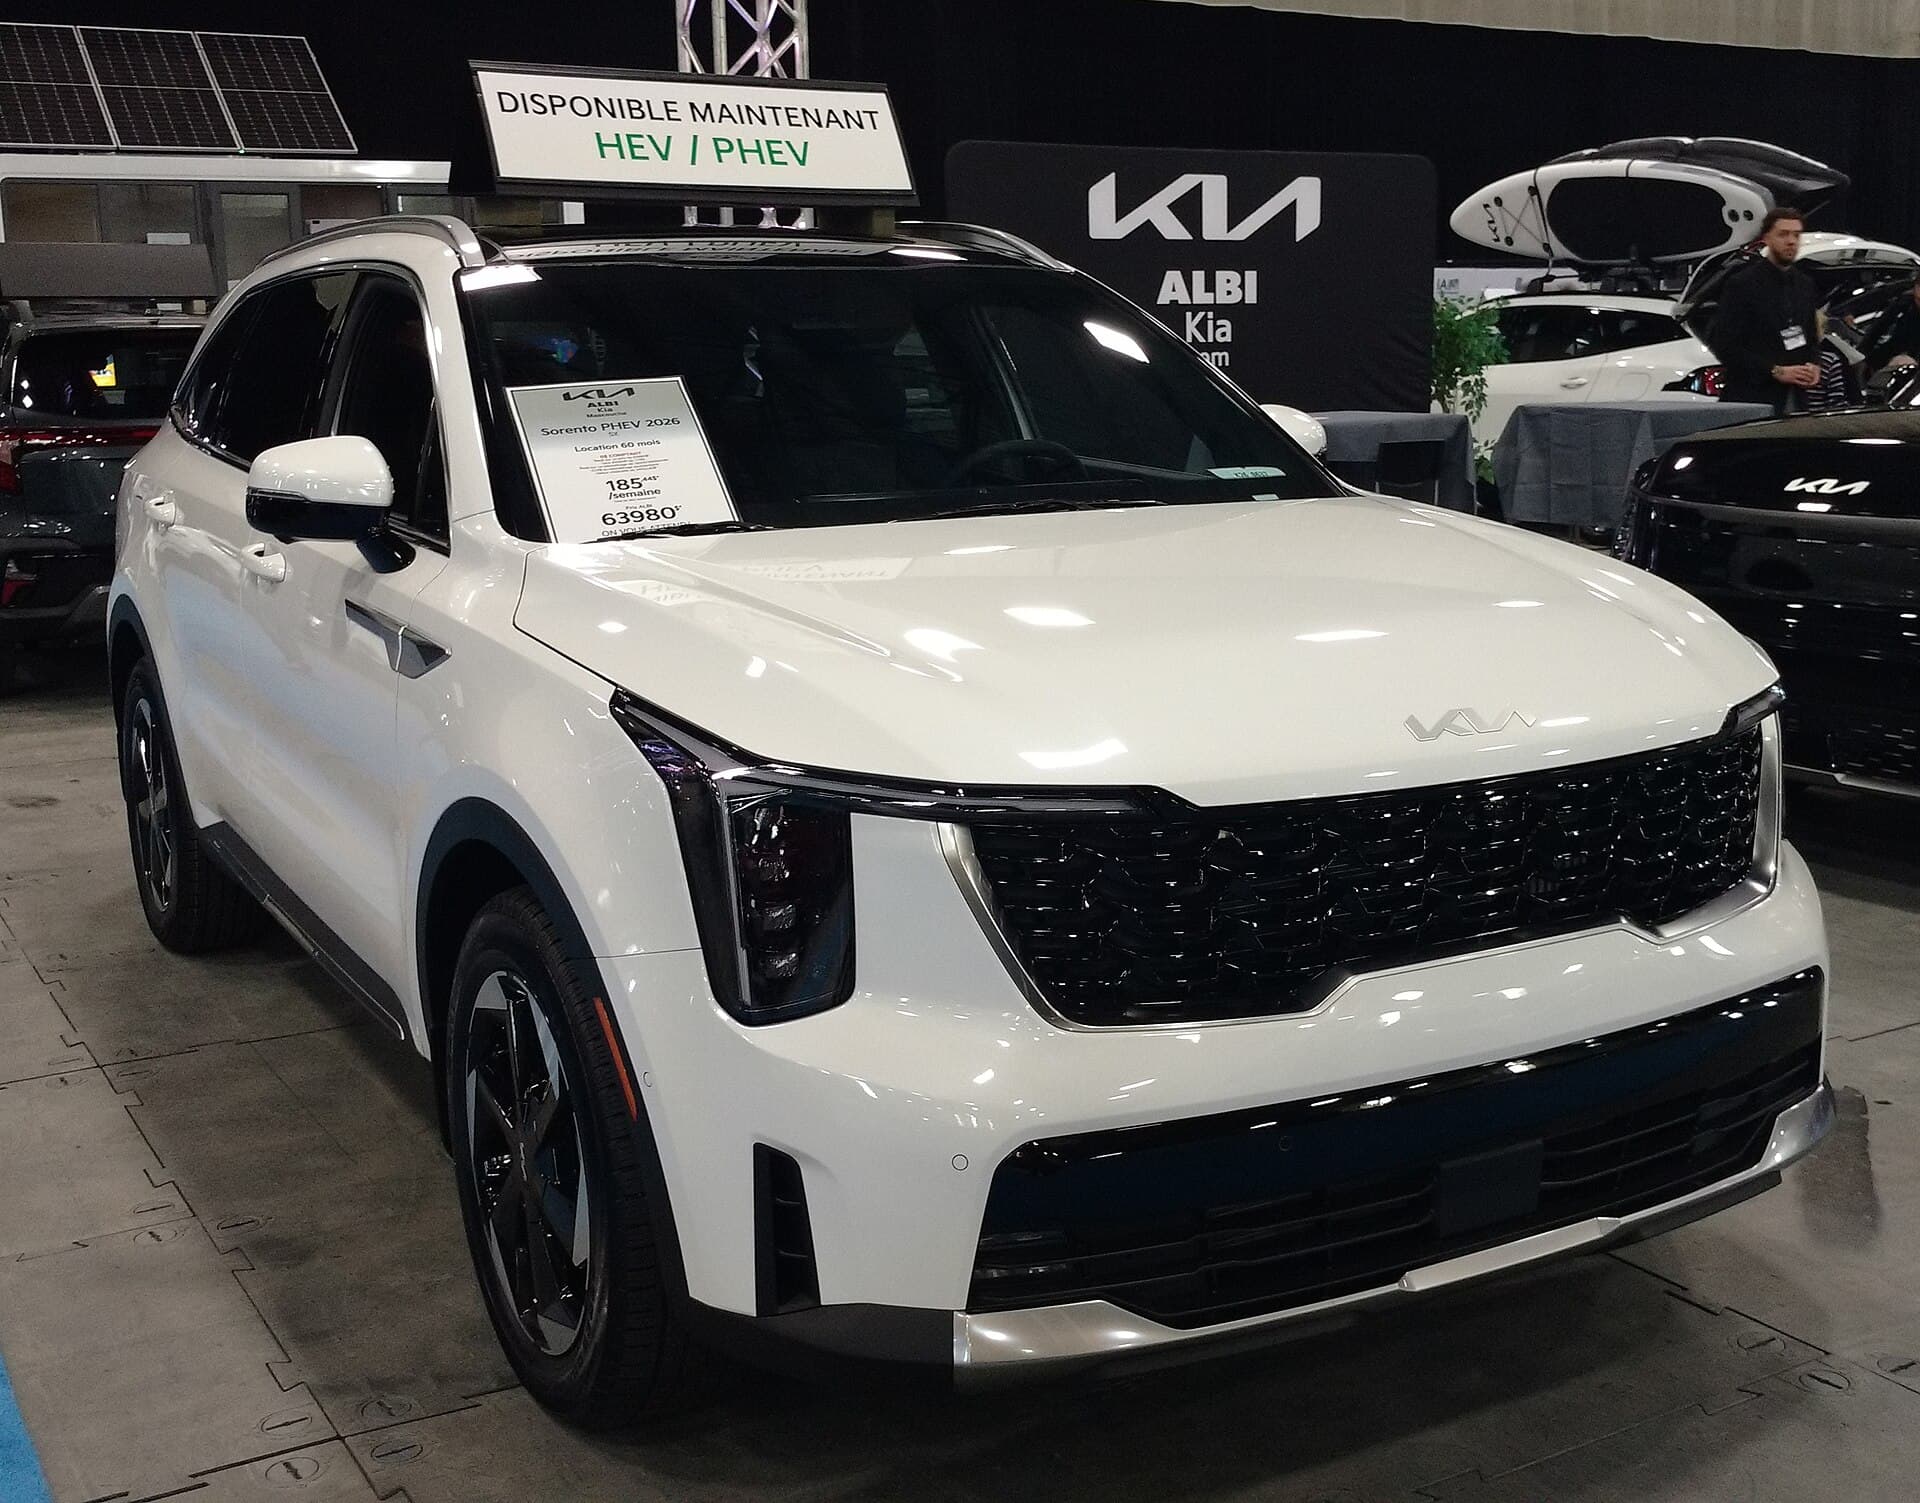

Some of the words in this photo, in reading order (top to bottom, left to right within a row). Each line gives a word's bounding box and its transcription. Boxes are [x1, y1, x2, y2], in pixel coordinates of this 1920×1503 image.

[496, 90, 682, 122] DISPONIBLE
[689, 101, 879, 131] MAINTENANT
[595, 131, 673, 162] HEV
[689, 134, 699, 166] /
[711, 136, 810, 167] PHEV
[1088, 171, 1322, 243] KIA
[1156, 270, 1258, 305] ALBI
[1185, 311, 1232, 343] Kia
[562, 387, 635, 401] KIA
[587, 400, 619, 408] ALBI
[541, 425, 597, 436] Sorento
[601, 419, 641, 432] PHEV
[645, 417, 681, 428] 2026
[575, 443, 619, 452] Location
[621, 441, 634, 449] 60
[637, 439, 661, 447] mois
[609, 488, 661, 500] /semaine
[1783, 477, 1871, 495] KIA
